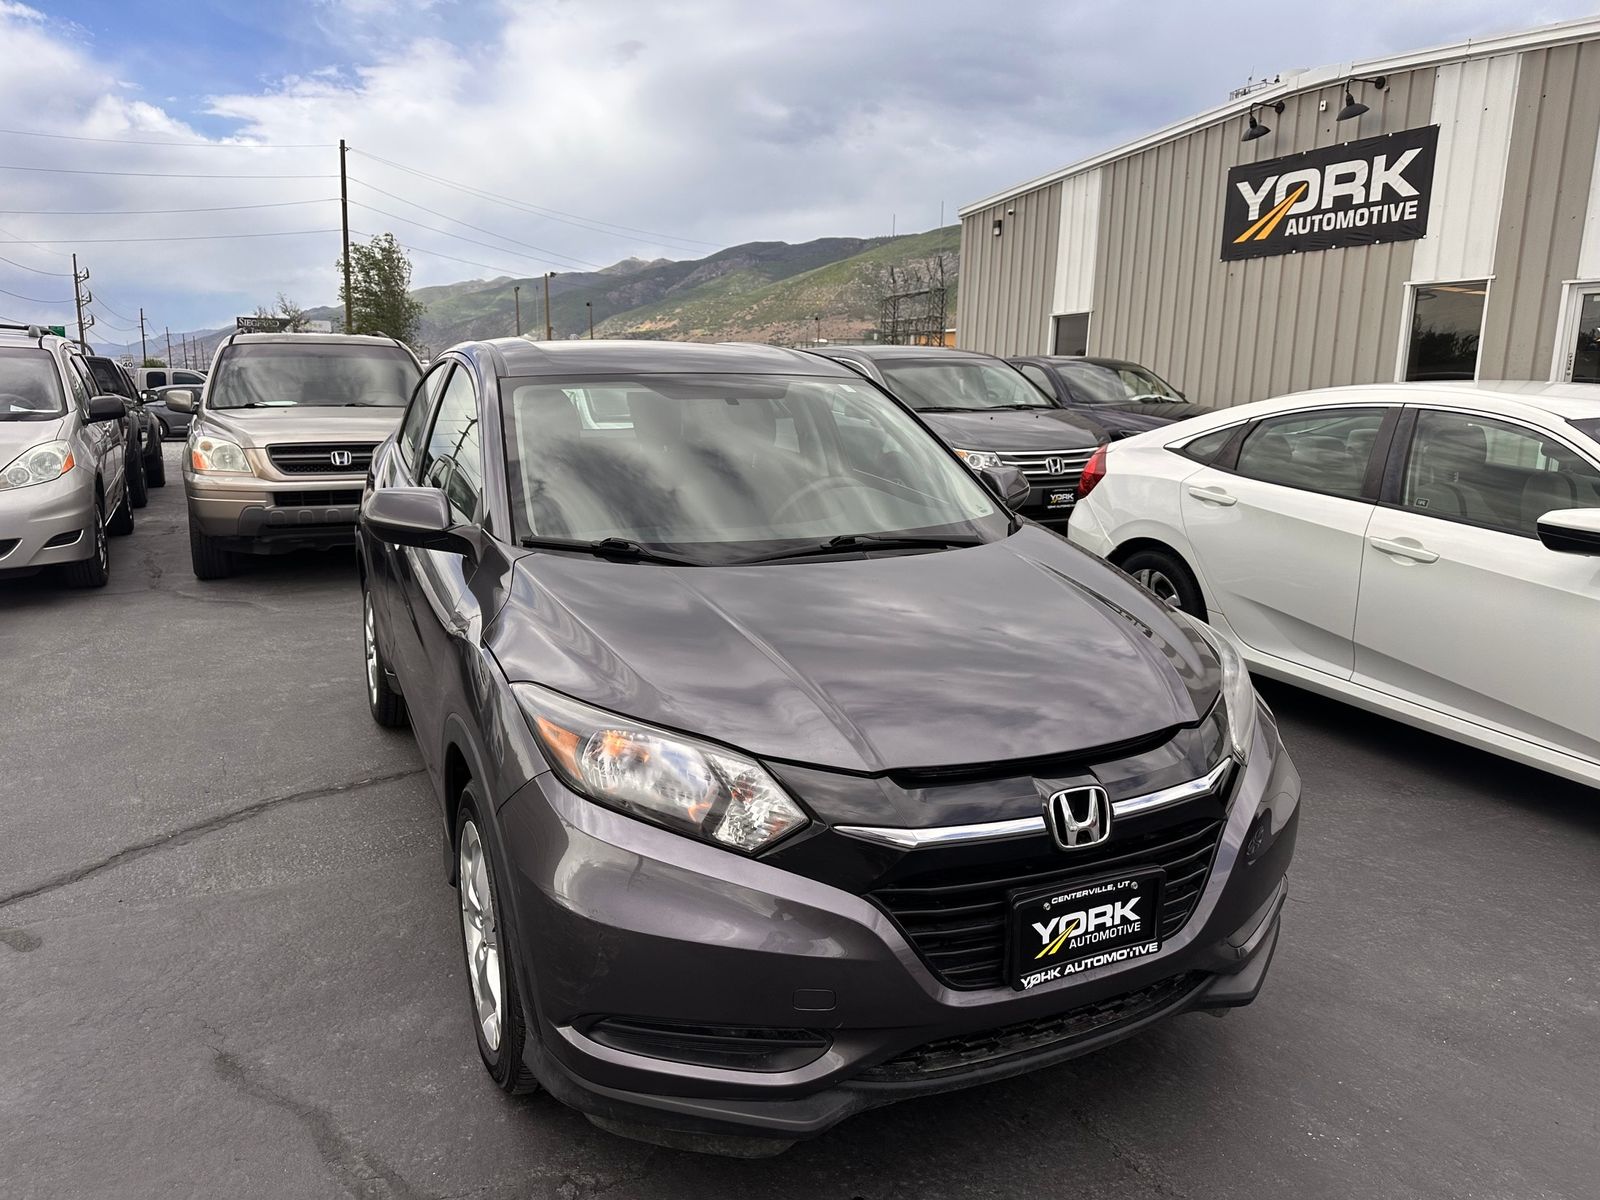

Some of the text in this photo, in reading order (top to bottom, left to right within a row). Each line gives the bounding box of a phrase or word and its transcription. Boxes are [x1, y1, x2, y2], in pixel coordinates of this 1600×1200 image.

[1236, 147, 1424, 222] YORK
[1284, 200, 1419, 237] AUTOMOTIVE
[1051, 880, 1131, 904] CENTERVILLE, UT
[1032, 896, 1142, 946] YORK
[1068, 921, 1142, 950] AUTOMOTIVE
[1063, 942, 1159, 976] AUTOMOTIVE
